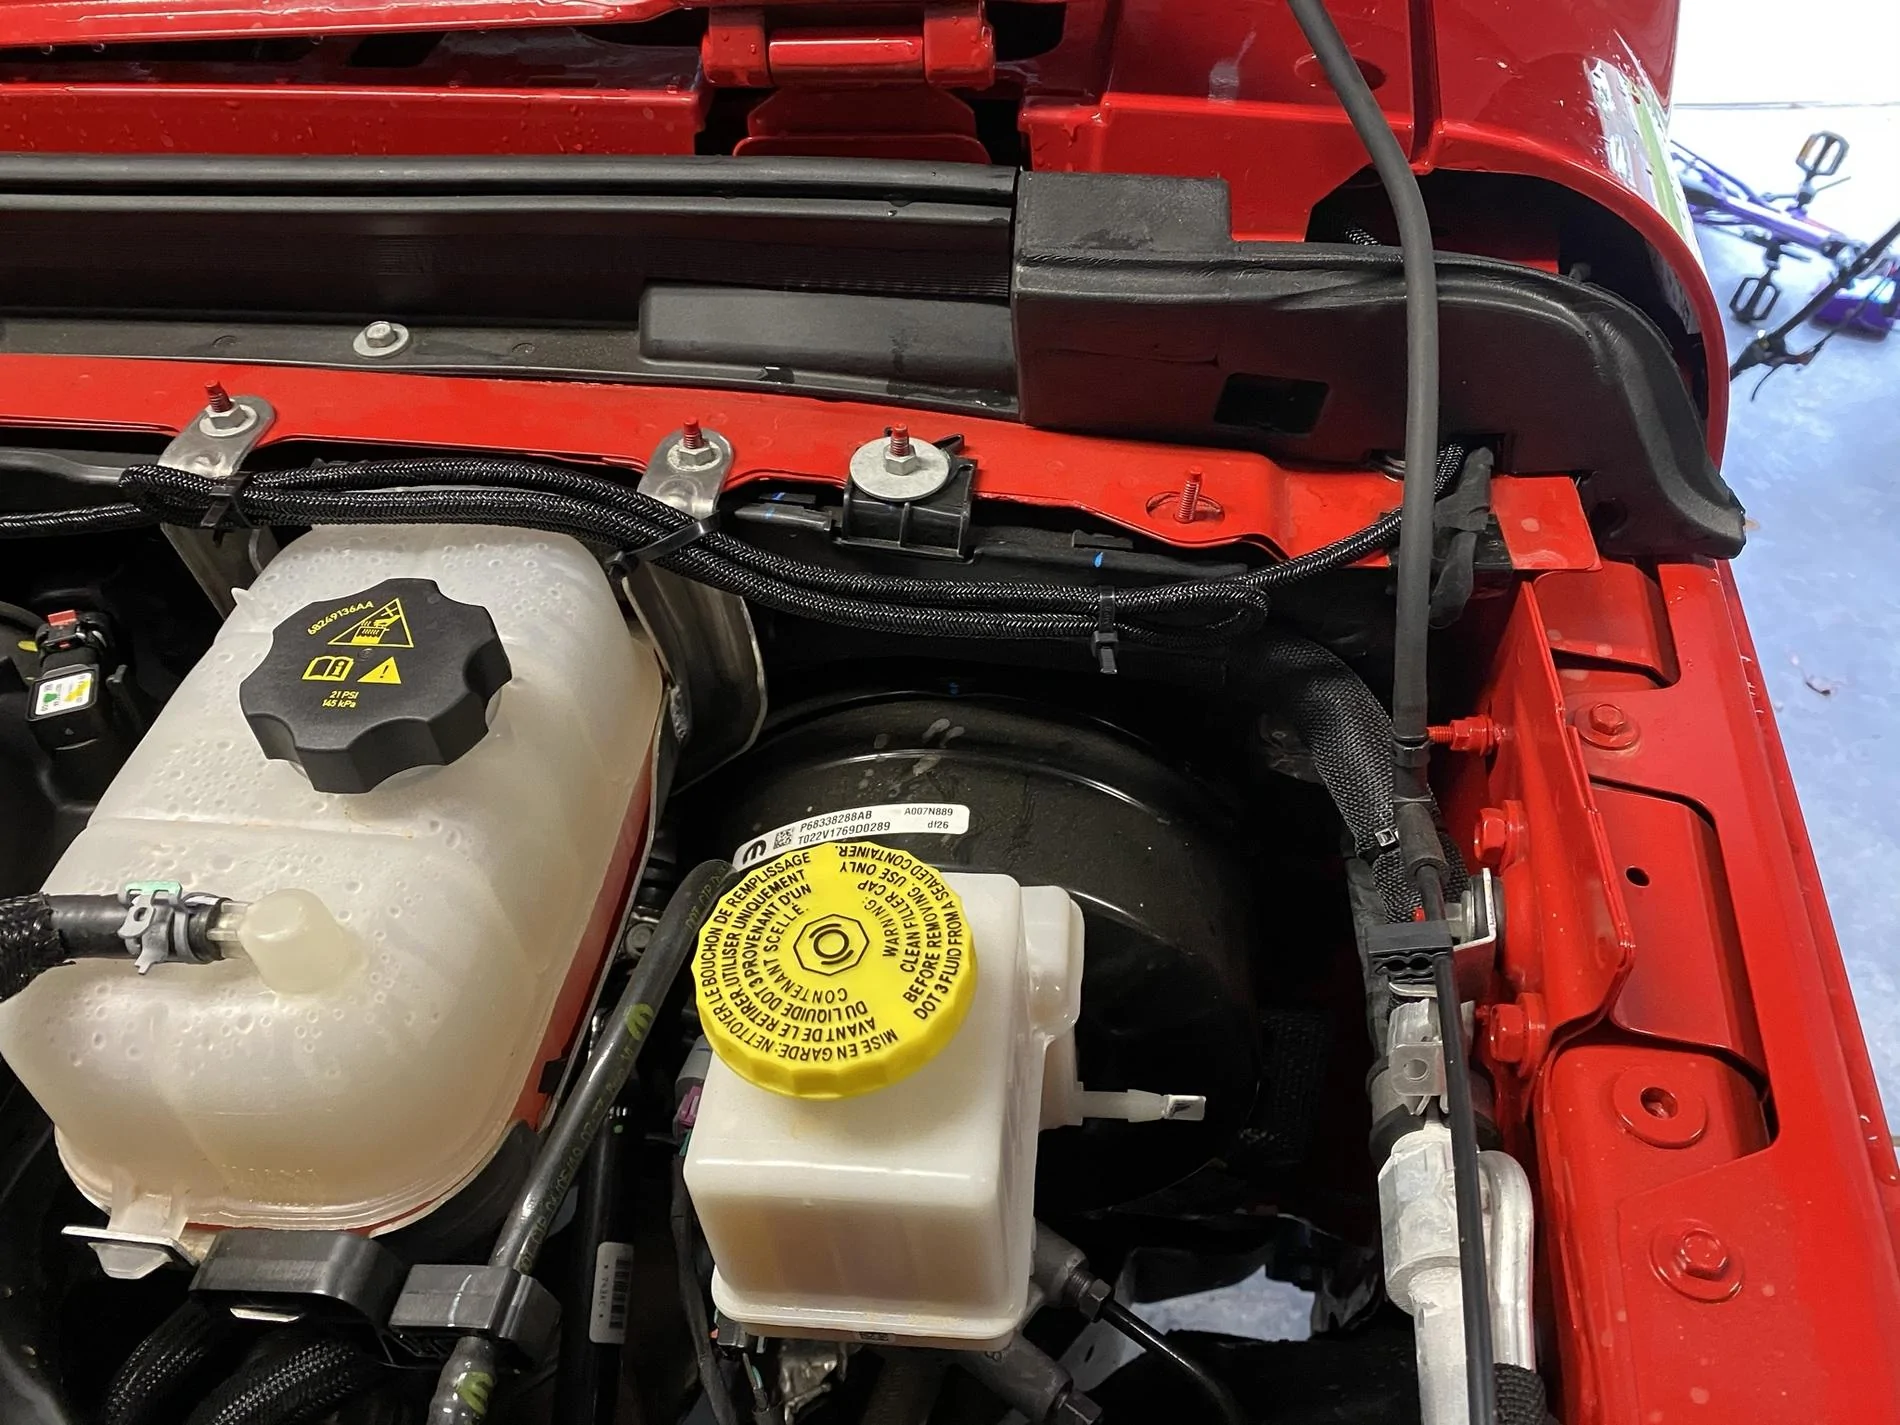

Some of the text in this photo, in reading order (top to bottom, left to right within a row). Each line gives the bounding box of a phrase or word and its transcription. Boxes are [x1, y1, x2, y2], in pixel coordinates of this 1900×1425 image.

[307, 600, 374, 635] 68249136AA
[322, 699, 356, 708] 145 kPa
[330, 690, 359, 700] 21 PSI
[800, 810, 872, 832] P68338288AB
[904, 807, 953, 816] A007N889
[798, 821, 891, 846] T022V1769D0289
[726, 852, 810, 907] REMPLISSAGE
[732, 869, 805, 929] UNIQUEMENT
[714, 908, 732, 924] DE
[858, 880, 920, 972] CLEAN FILLER CAP
[862, 897, 899, 957] WARNING:
[835, 846, 962, 1020] DOT 3 FLUID FROM A SEALED CONTAINER.
[840, 861, 941, 1002] BEFORE REMOVING. USE ONLY
[701, 927, 722, 986] BOUCHON
[743, 884, 867, 1023] DU LIQUIDE DOT 3 PROVENANT D'UN
[763, 959, 847, 1003] CONTENANT
[705, 988, 722, 1004] LE
[713, 1003, 774, 1053] NETTOYER
[778, 1023, 799, 1039] LE
[802, 1028, 823, 1041] DE
[826, 1017, 875, 1042] AVANT
[775, 1043, 832, 1061] GARDE:
[837, 1043, 858, 1059] EN
[861, 1029, 898, 1053] MISE
